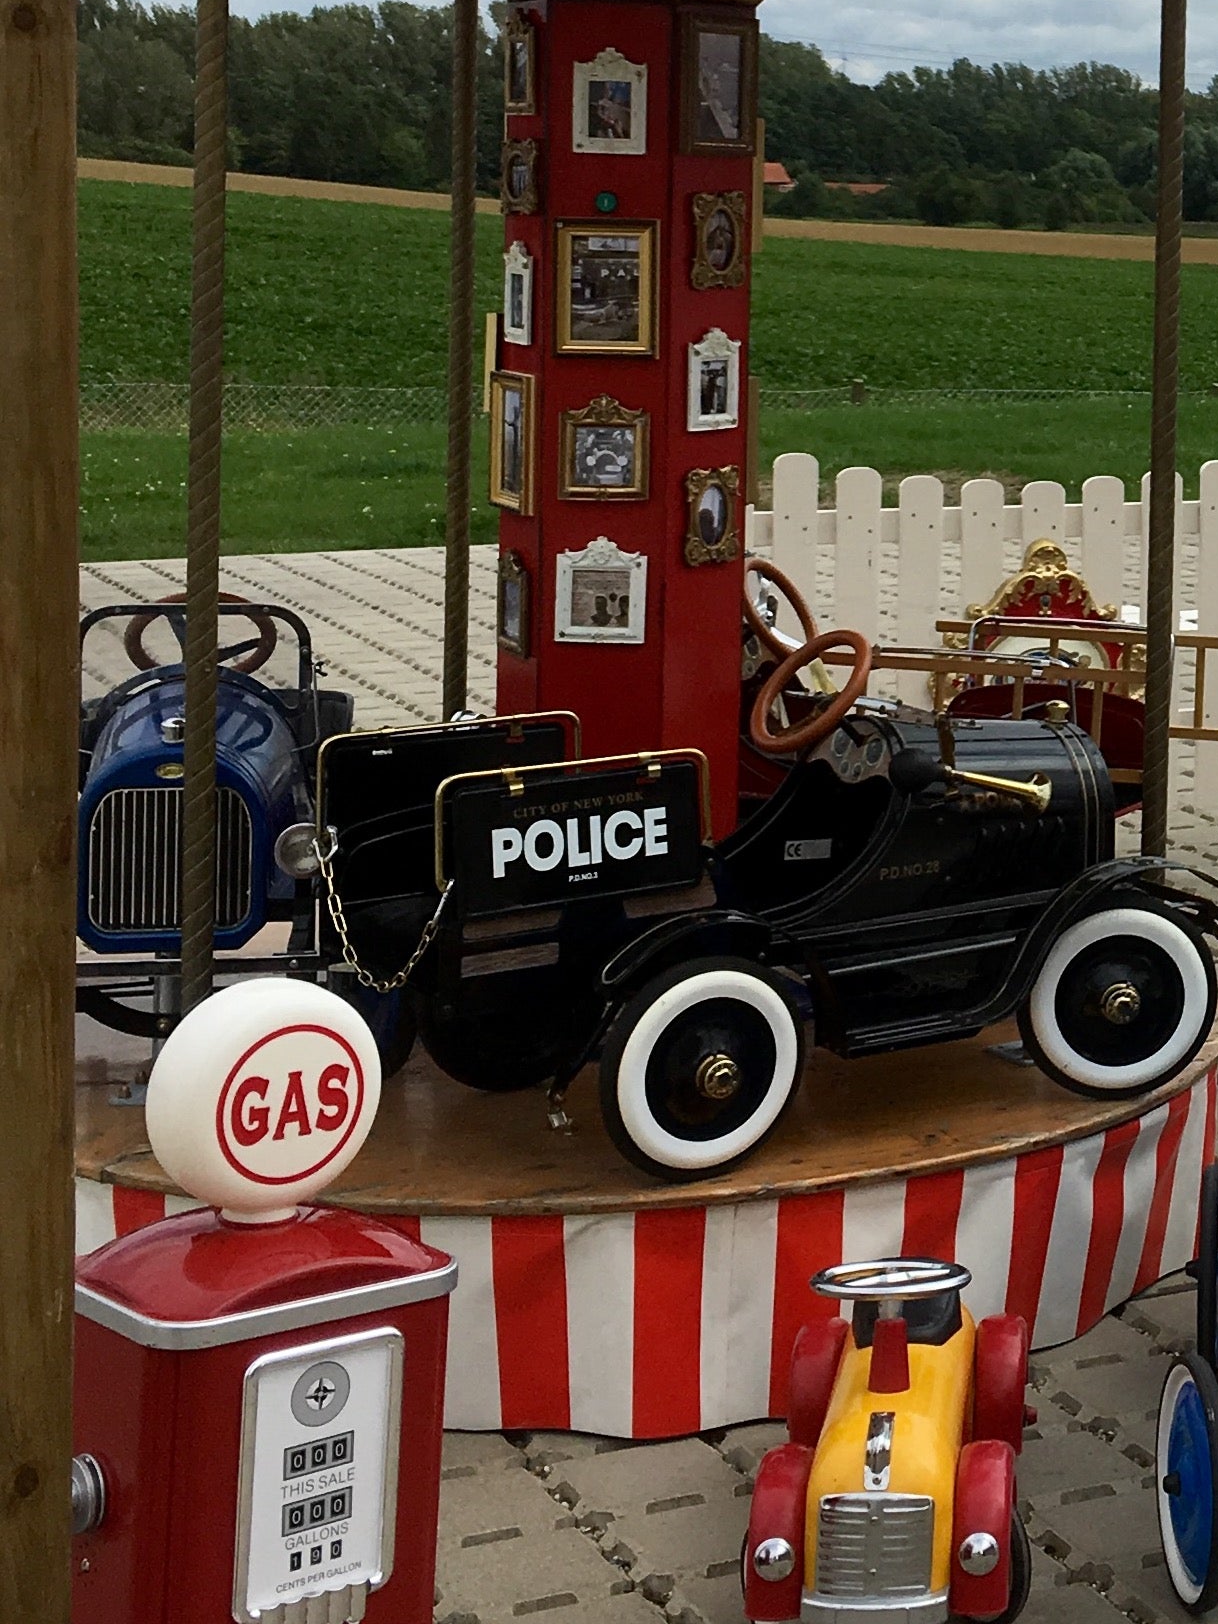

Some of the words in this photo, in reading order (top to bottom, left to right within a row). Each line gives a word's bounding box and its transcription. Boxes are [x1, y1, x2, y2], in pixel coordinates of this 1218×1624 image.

[513, 804, 548, 819] CITY
[551, 801, 569, 813] OF
[574, 796, 603, 810] NEW
[607, 791, 644, 805] YORK
[491, 806, 668, 878] POLICE
[230, 1063, 351, 1149] GAS
[280, 1478, 315, 1499] THIS
[318, 1467, 356, 1489] SALE
[285, 1521, 350, 1551] GALLONS
[276, 1577, 306, 1594] CENTS
[307, 1571, 325, 1584] PER
[326, 1561, 362, 1579] GALLON
